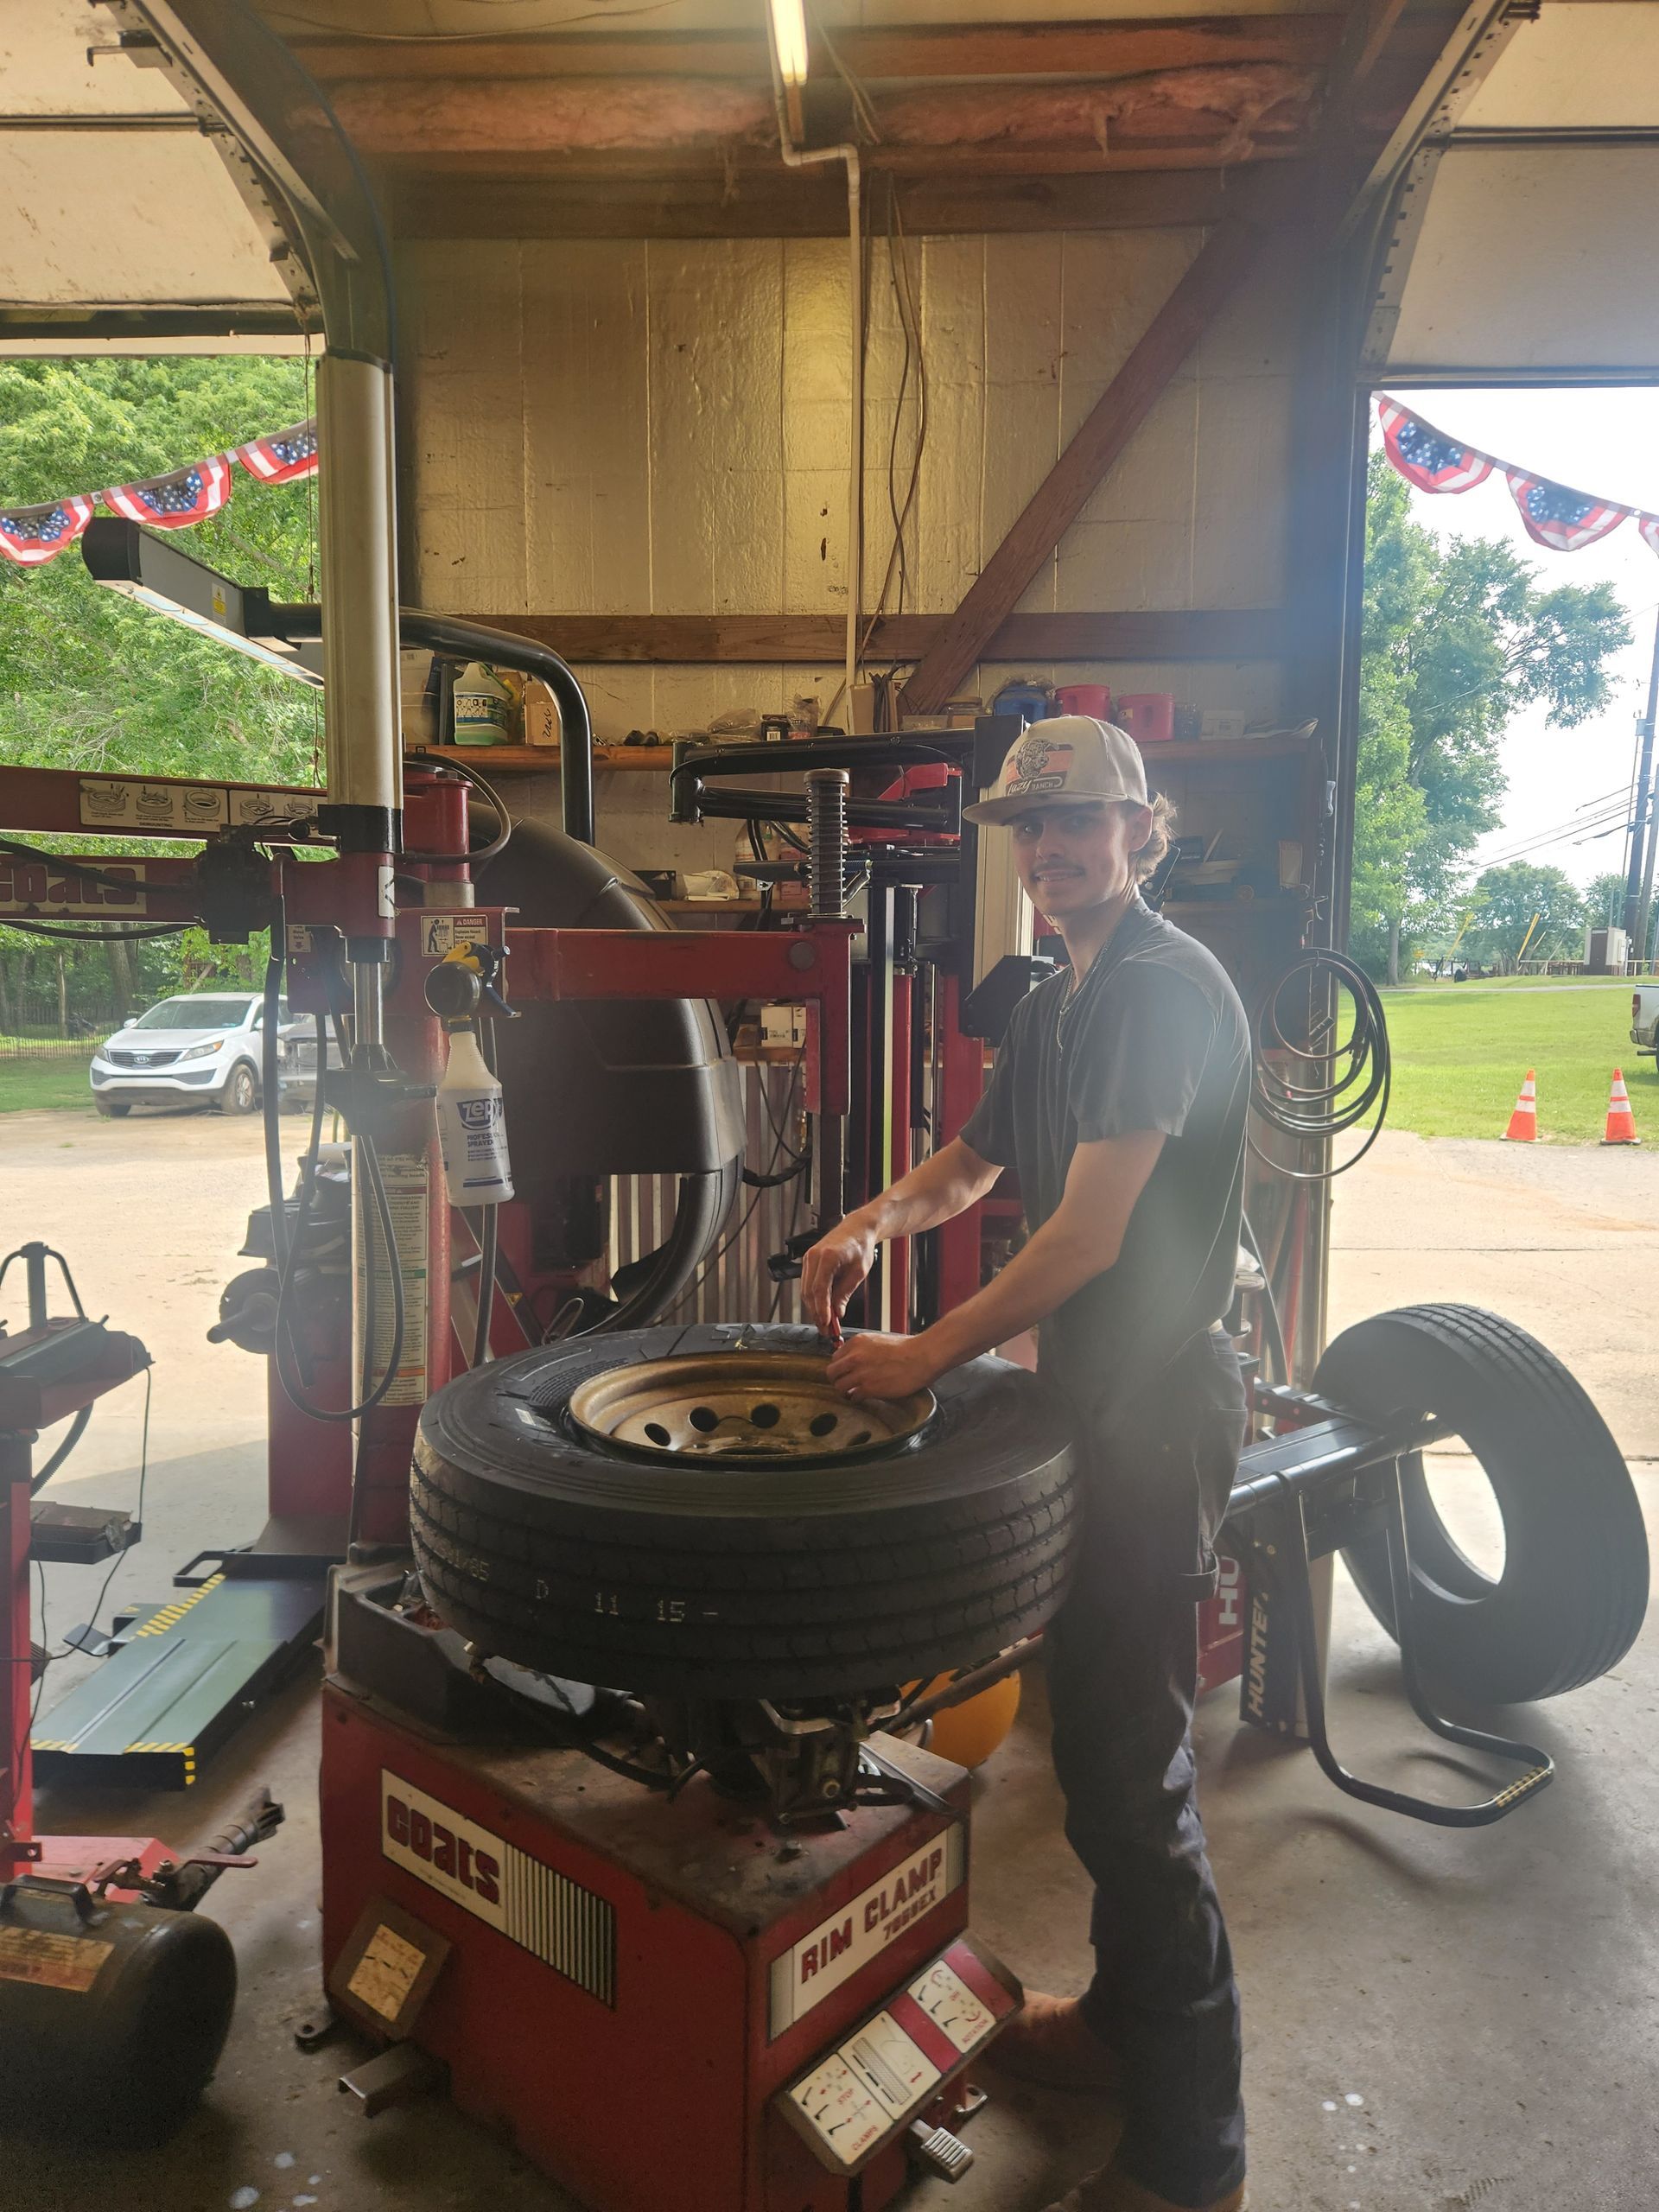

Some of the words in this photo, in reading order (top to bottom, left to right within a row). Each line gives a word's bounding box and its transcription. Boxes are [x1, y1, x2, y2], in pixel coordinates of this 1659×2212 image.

[1032, 781, 1053, 790] RANCH
[594, 1591, 620, 1616] 11
[656, 1597, 685, 1623] 15
[800, 1916, 852, 1985] RIM
[863, 1847, 943, 1934] CLAMP
[962, 2018, 988, 2044] ROTATION
[836, 2087, 855, 2106] STOP
[851, 2123, 879, 2152] CLAMPS
